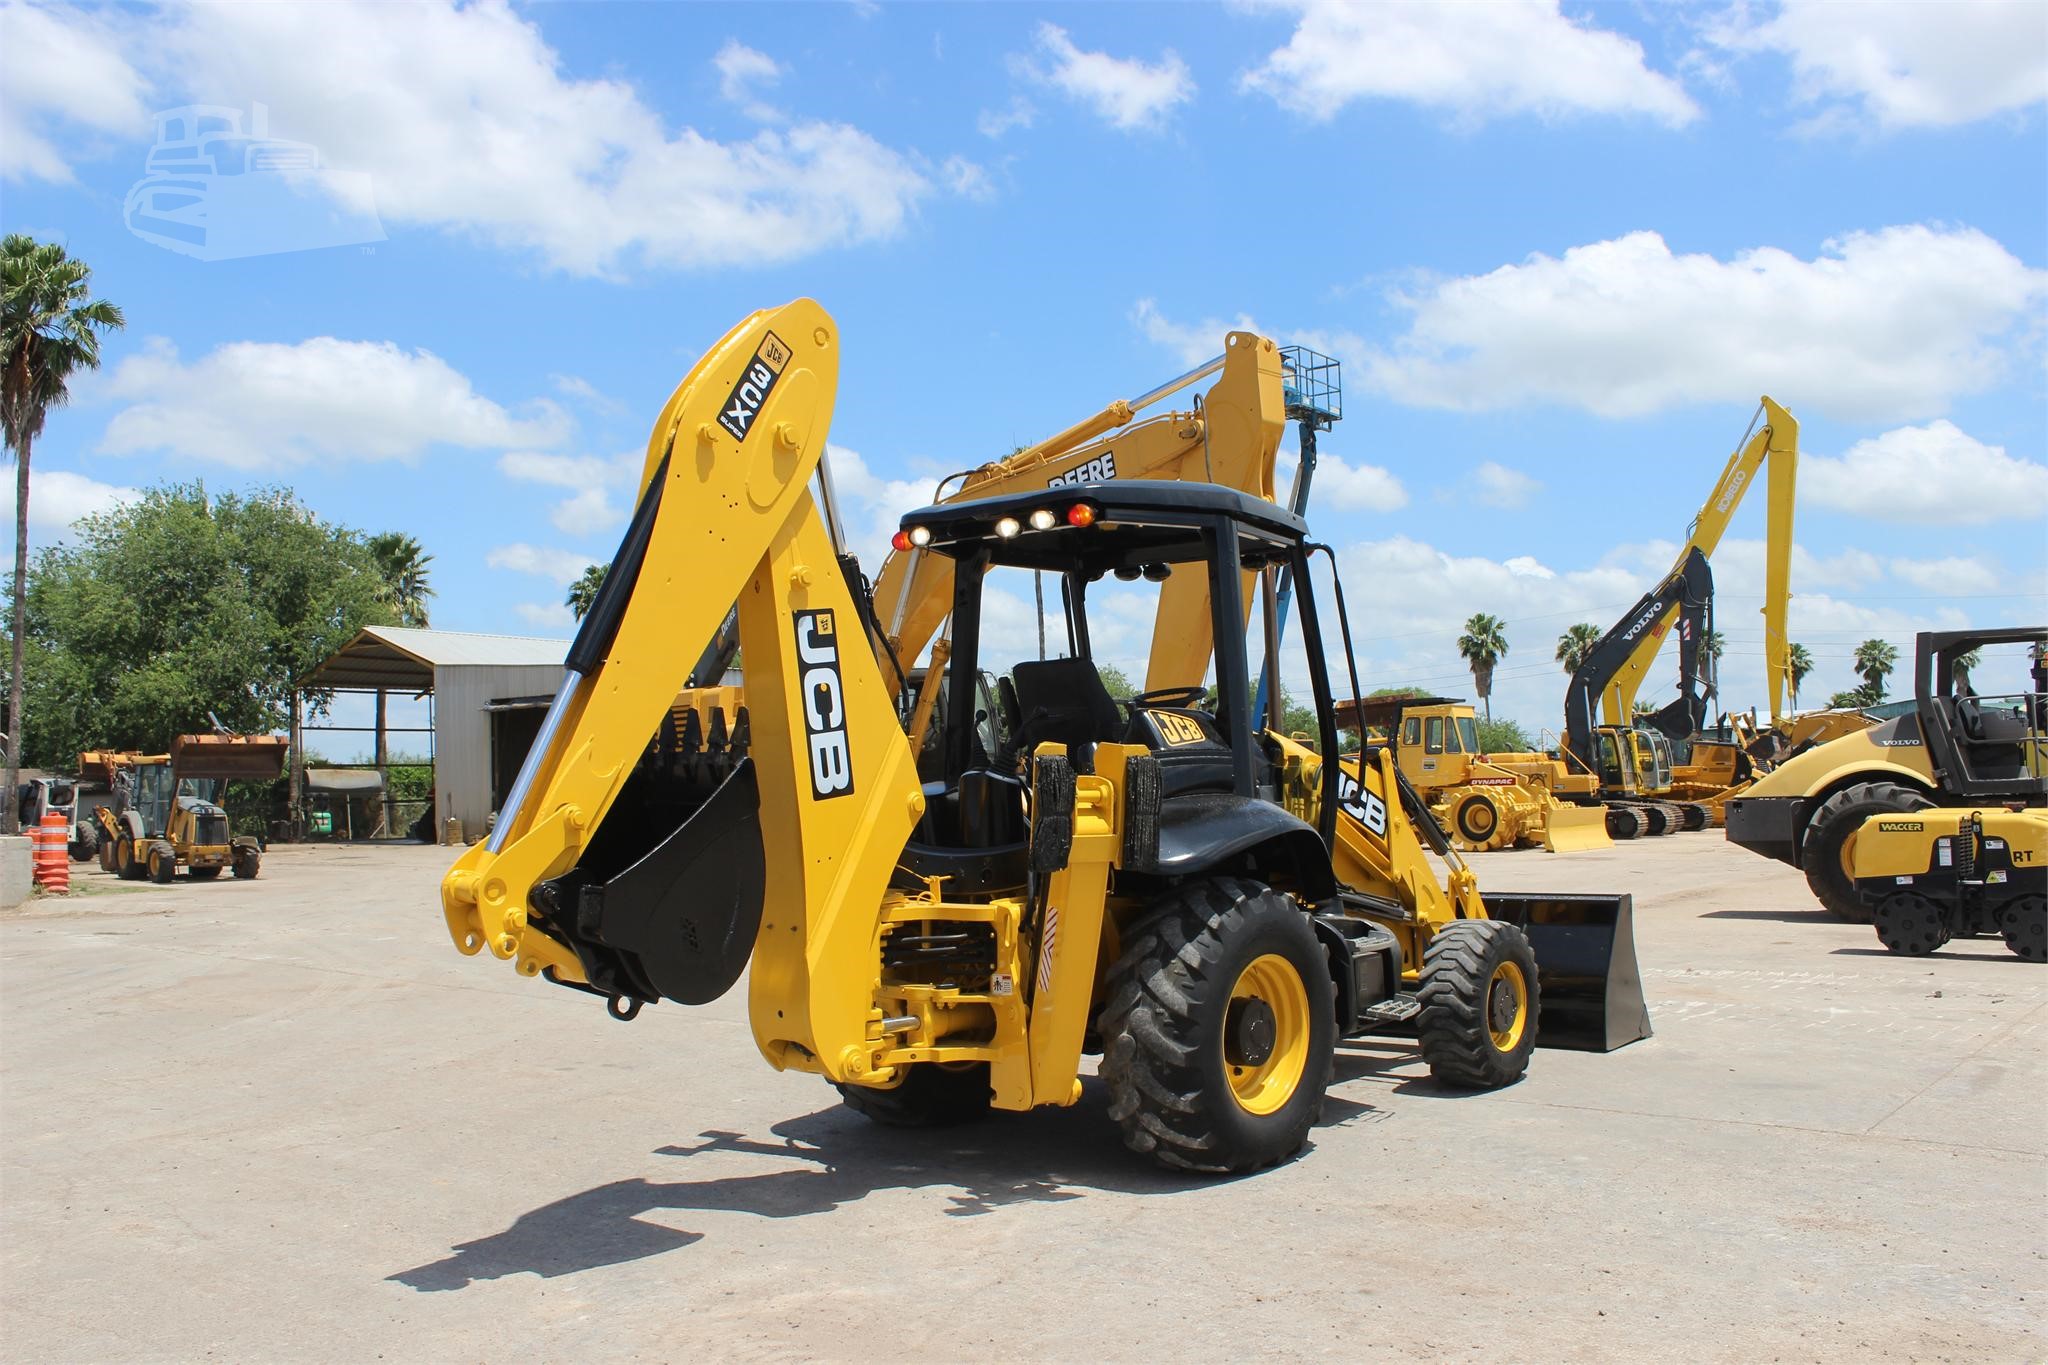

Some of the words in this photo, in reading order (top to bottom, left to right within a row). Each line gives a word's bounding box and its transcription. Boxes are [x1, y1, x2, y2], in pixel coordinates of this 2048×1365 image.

[766, 342, 783, 364] JCB
[726, 363, 772, 430] 3CX
[720, 416, 744, 439] SUPER
[1717, 471, 1746, 513] KOBELCO
[1622, 601, 1663, 640] VOLVO
[797, 615, 850, 794] JCB
[1157, 713, 1202, 743] JCB
[1471, 778, 1513, 786] DYNAPAC
[1880, 823, 1922, 831] WACKER
[2012, 850, 2033, 863] RT
